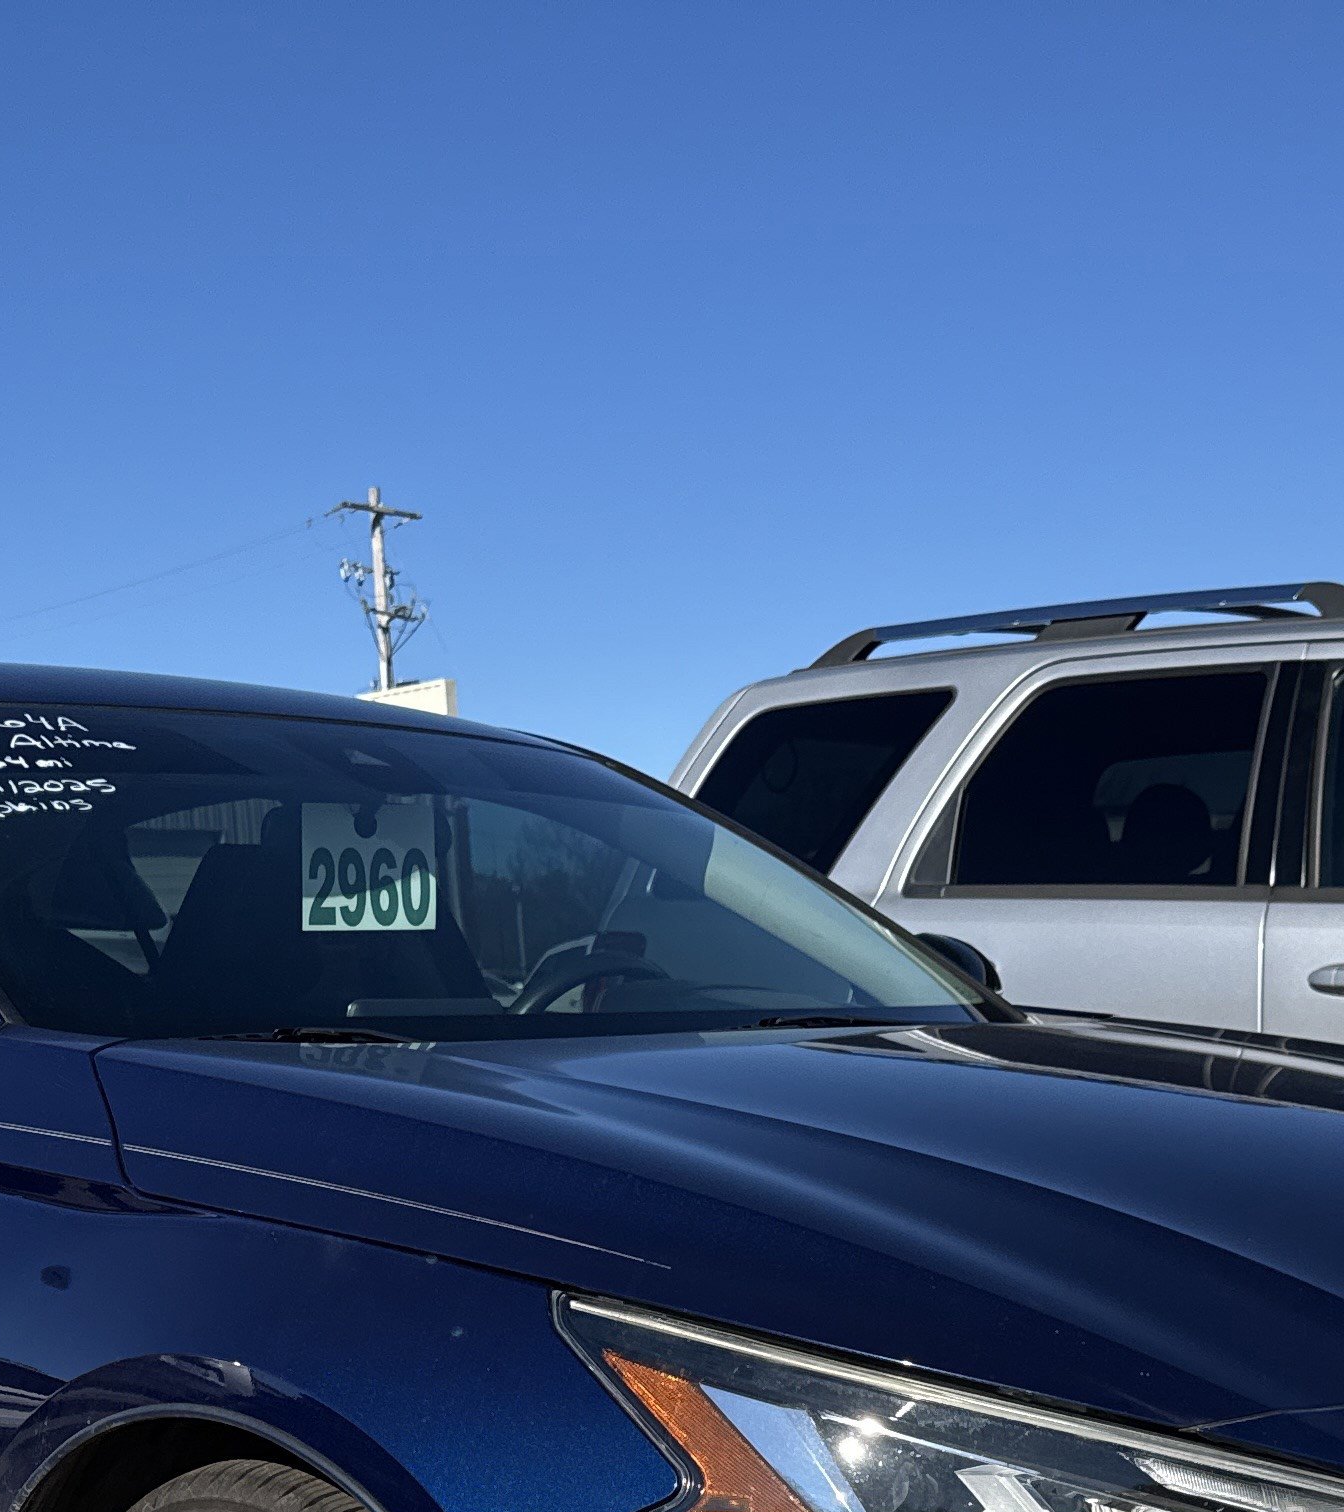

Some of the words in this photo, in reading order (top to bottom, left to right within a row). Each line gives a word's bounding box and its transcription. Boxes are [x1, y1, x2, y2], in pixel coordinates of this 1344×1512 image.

[10, 733, 138, 751] Altima
[35, 756, 73, 768] mi
[307, 846, 431, 927] 2960
